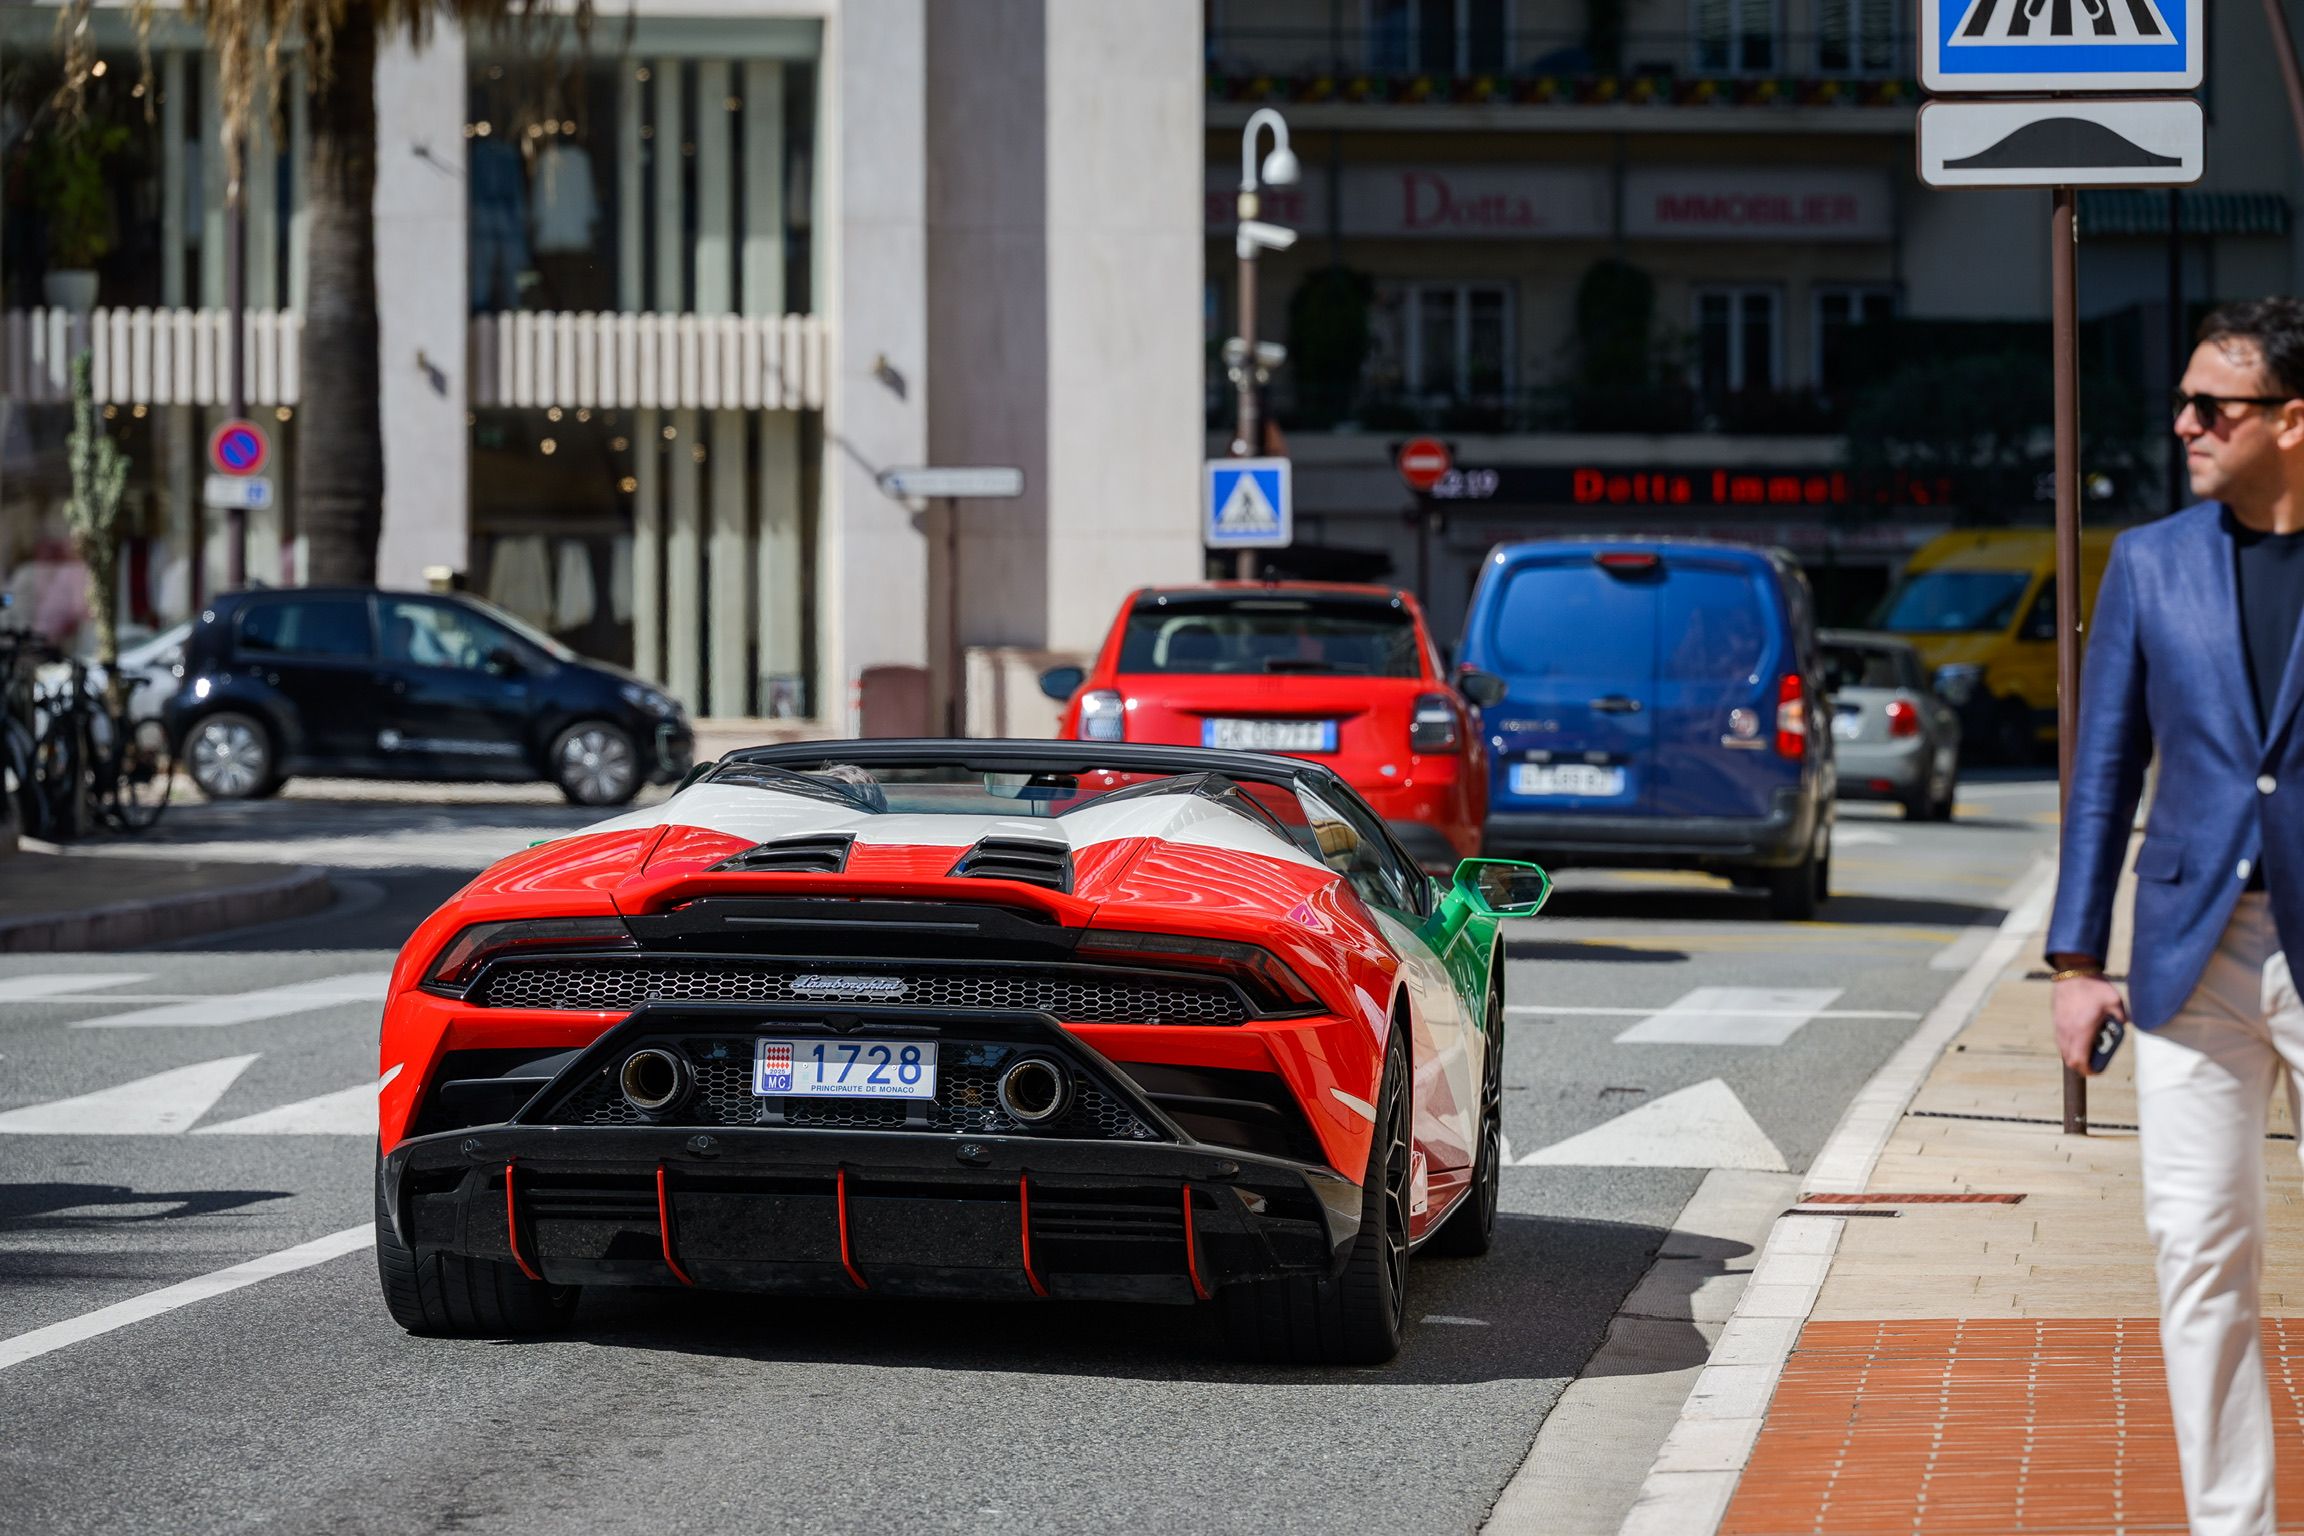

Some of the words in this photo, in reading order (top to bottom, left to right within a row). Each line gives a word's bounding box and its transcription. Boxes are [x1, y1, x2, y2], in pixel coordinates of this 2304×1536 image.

[1402, 171, 1548, 228] Dotta
[1656, 194, 1857, 222] IMMOBILIER
[1572, 466, 1694, 505] Dotta
[790, 975, 903, 993] Lamborghini
[813, 1044, 921, 1085] 1728
[768, 1076, 786, 1089] MC
[811, 1085, 863, 1093] PRINCIPAUTE
[880, 1086, 915, 1094] MONACO
